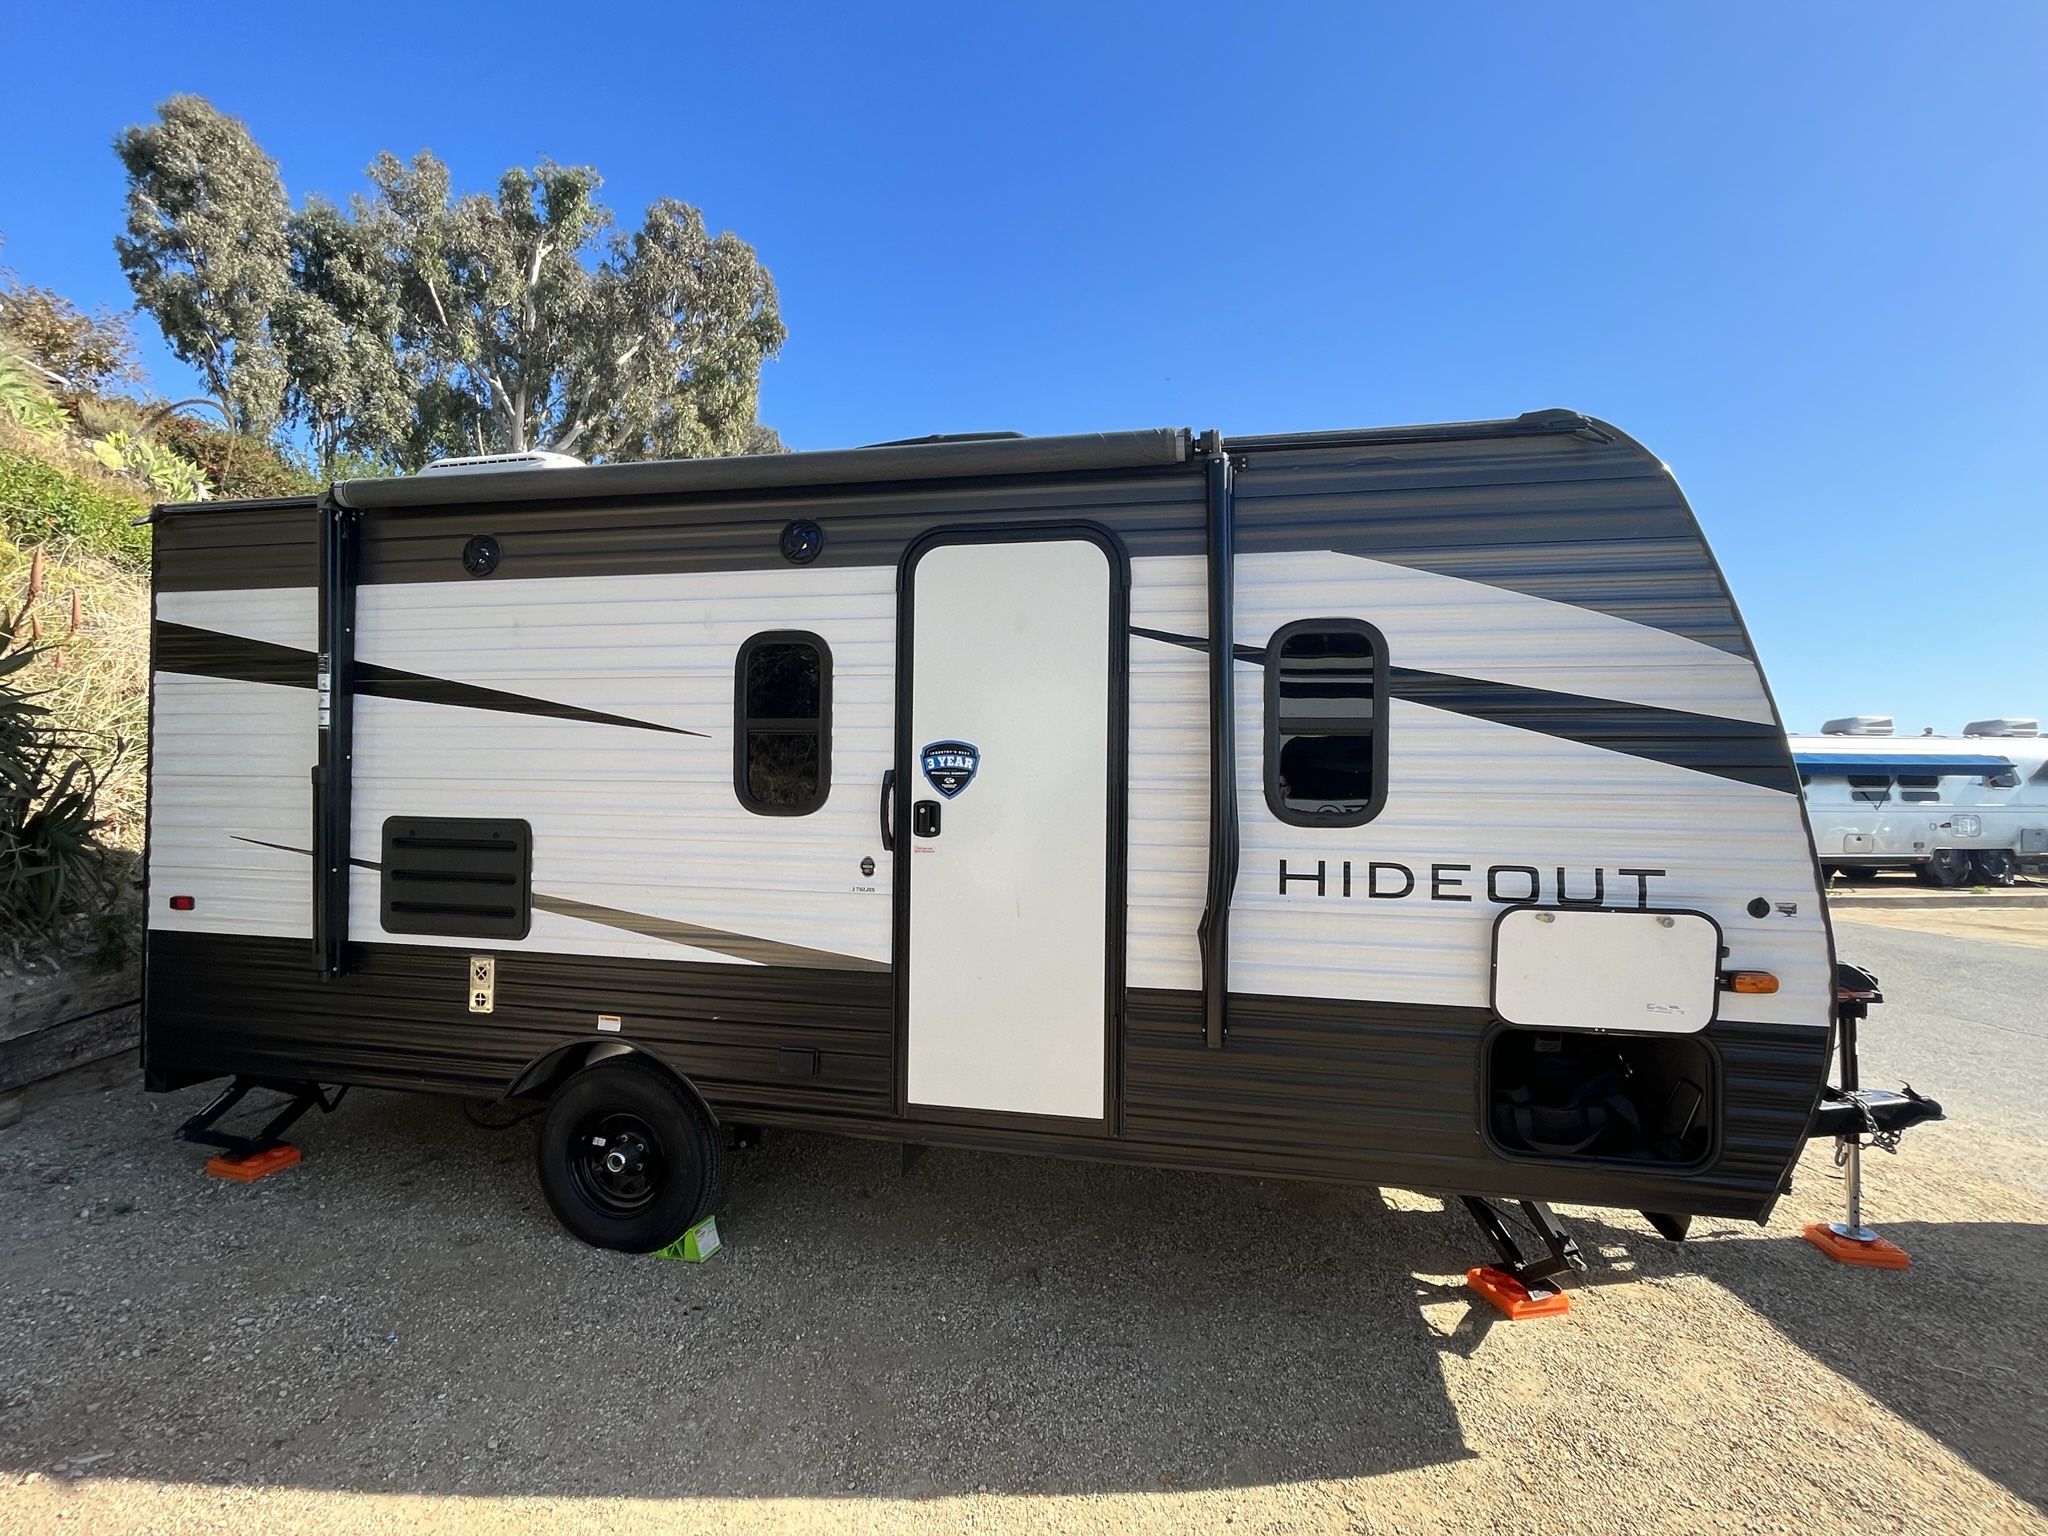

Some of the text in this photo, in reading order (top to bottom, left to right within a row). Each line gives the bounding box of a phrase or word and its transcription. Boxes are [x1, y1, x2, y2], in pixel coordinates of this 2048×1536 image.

[926, 755, 973, 769] 3 YEAR
[1279, 859, 1666, 909] HIDEOUT
